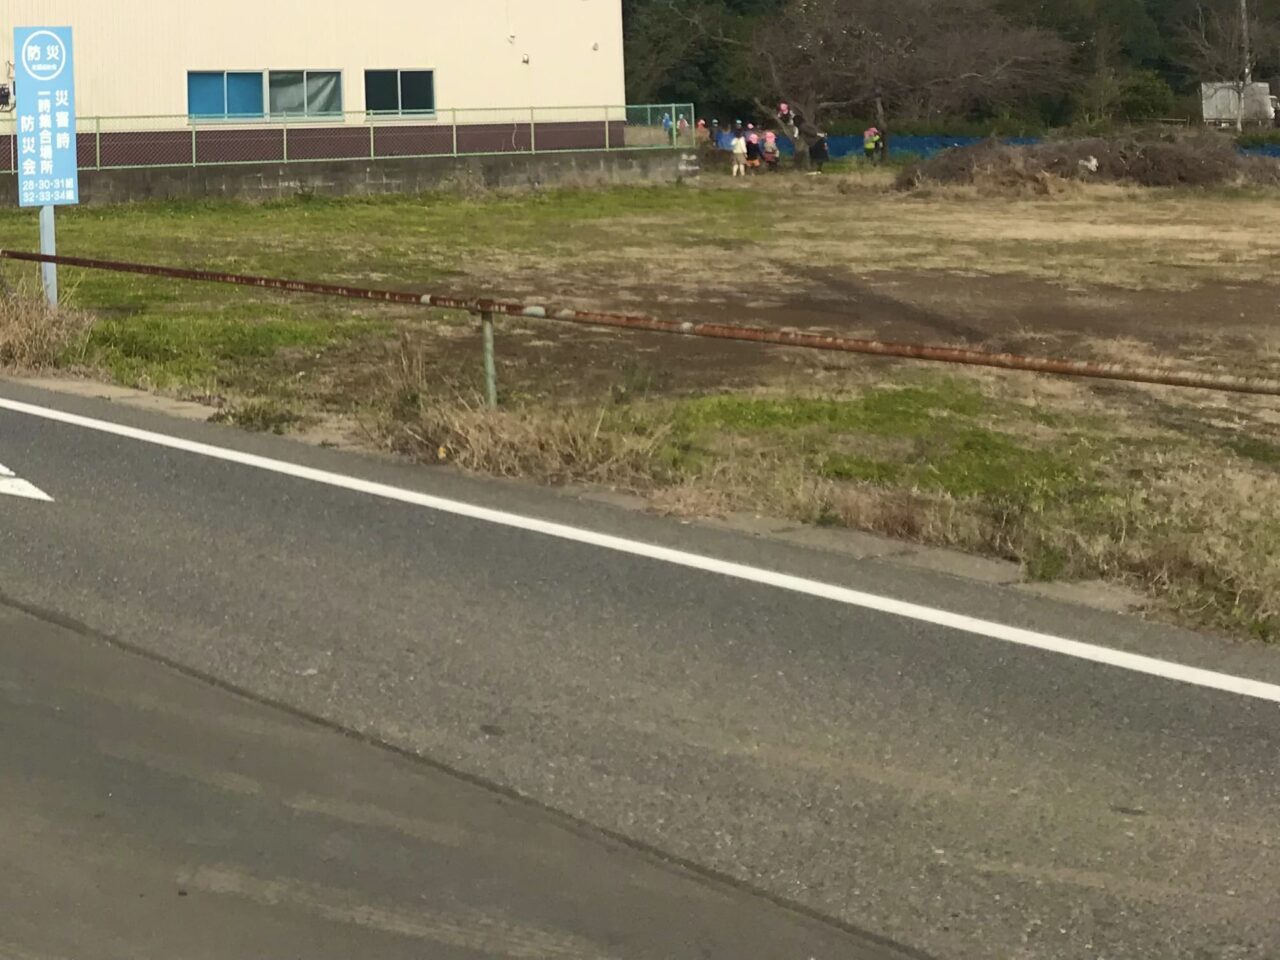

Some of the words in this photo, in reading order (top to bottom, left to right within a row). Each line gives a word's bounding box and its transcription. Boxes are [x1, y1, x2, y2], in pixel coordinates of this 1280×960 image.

[27, 45, 59, 61] 防災
[21, 115, 37, 176] 防災会
[38, 91, 53, 175] 一時集合場所
[55, 89, 71, 150] 災害時
